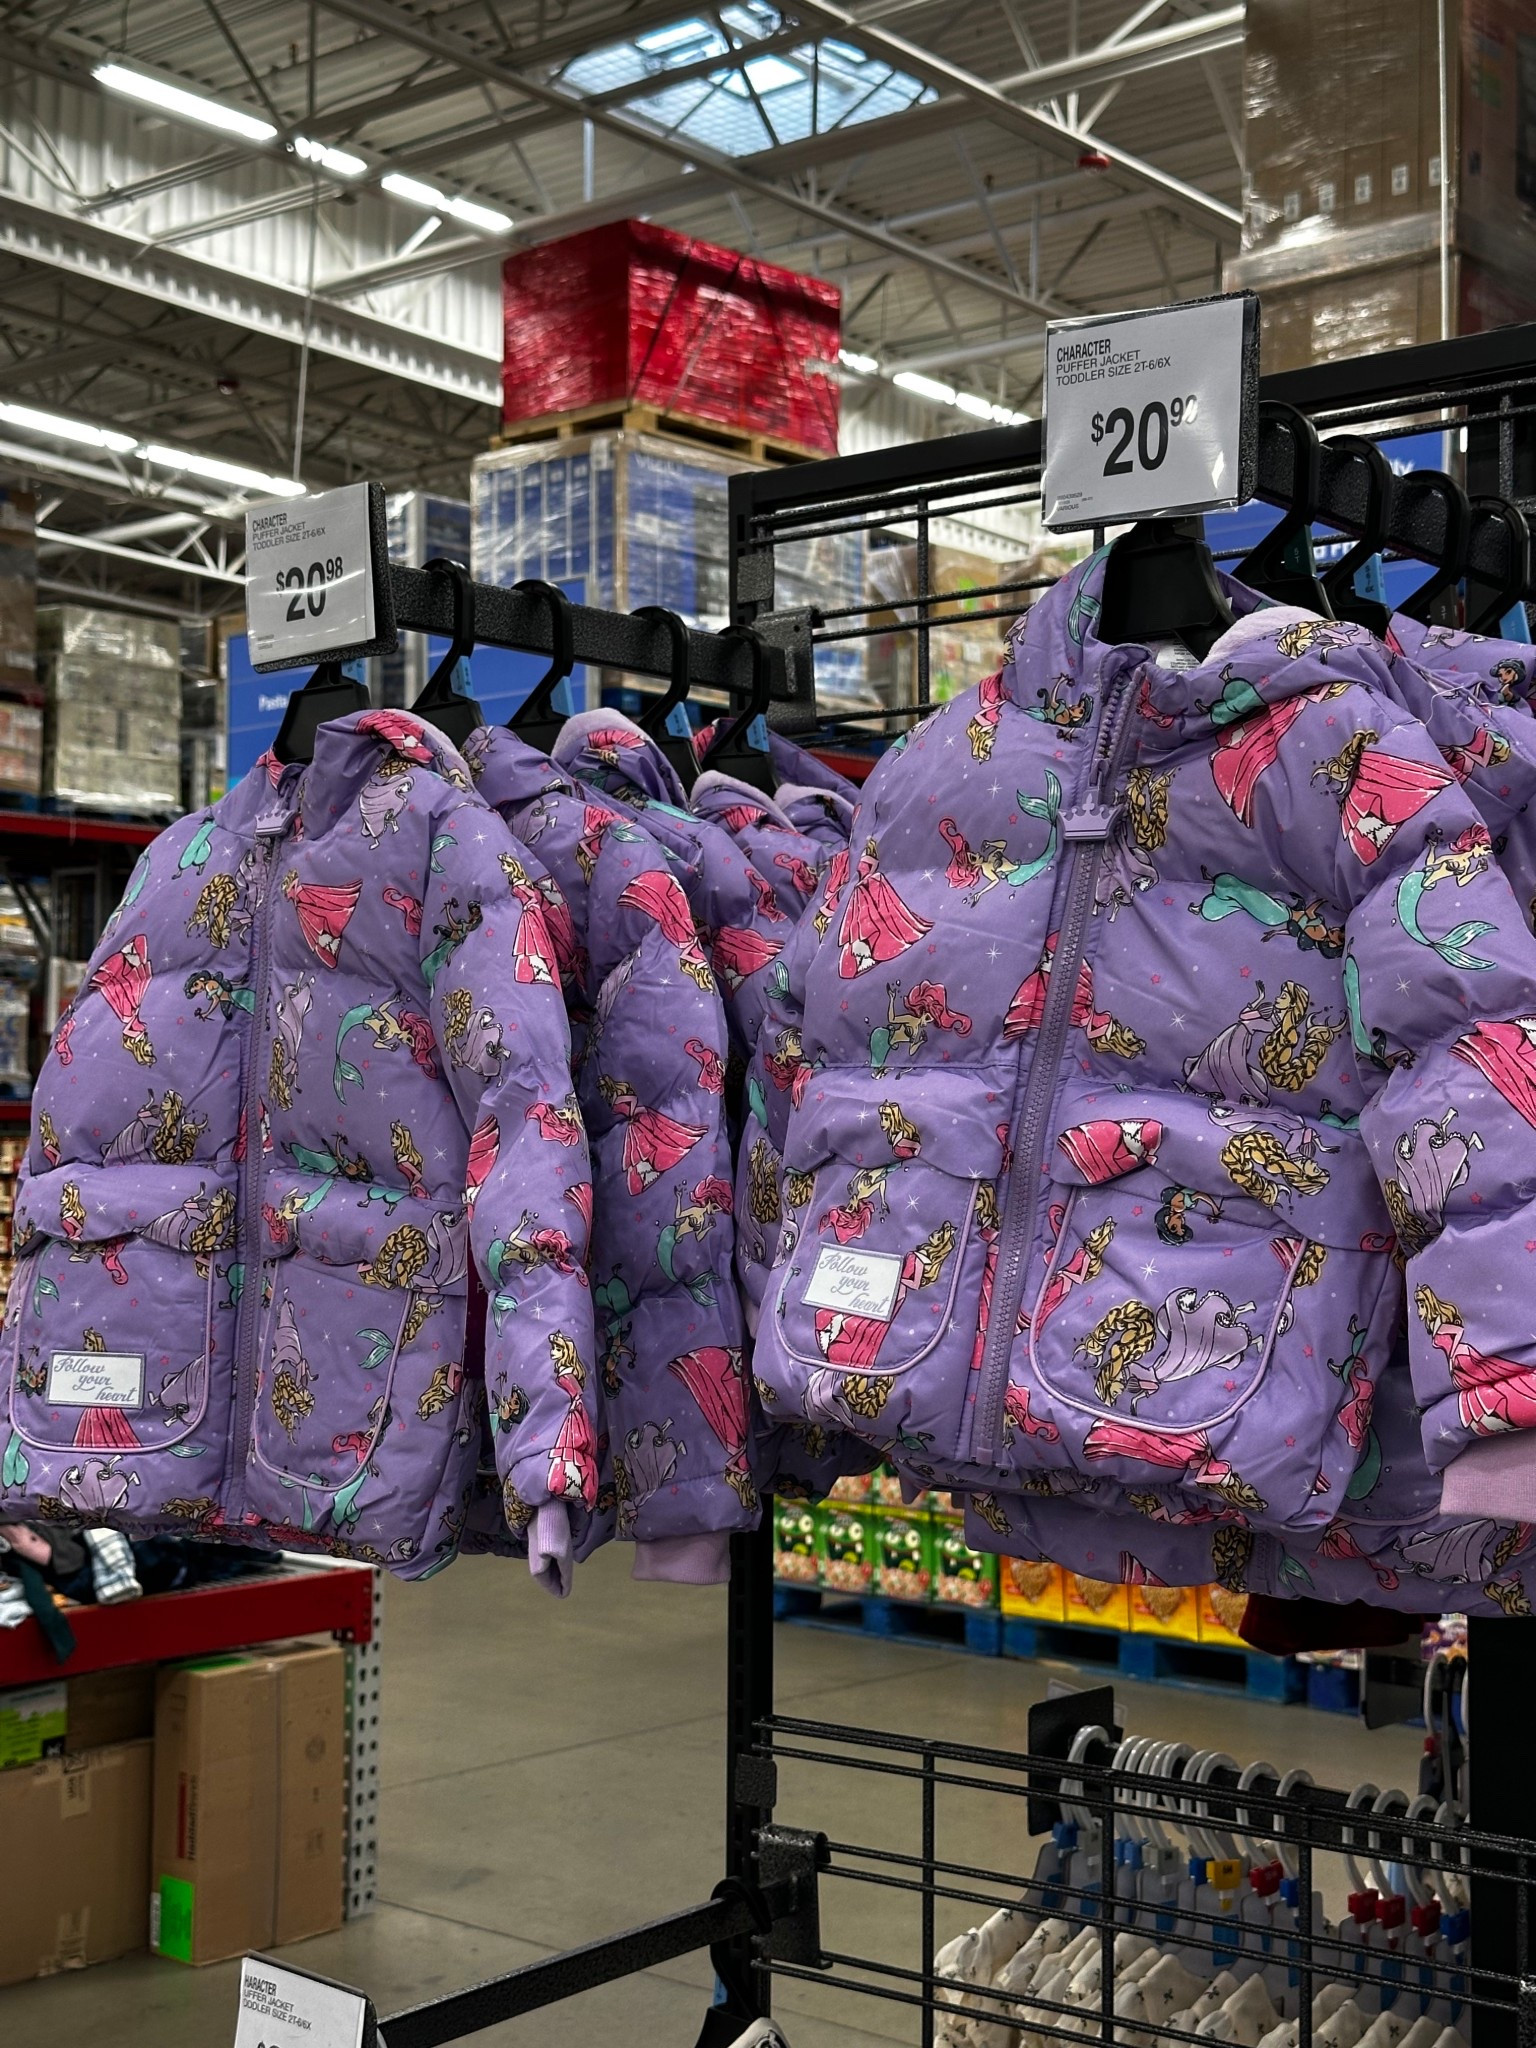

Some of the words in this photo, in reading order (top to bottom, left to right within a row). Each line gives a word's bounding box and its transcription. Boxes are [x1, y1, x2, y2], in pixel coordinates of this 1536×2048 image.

[1057, 339, 1111, 363] CHARACTER
[1056, 358, 1098, 375] PUFFER
[1100, 350, 1141, 367] JACKET
[1056, 369, 1105, 386] TODDLER
[1108, 364, 1131, 377] SIZE
[1133, 356, 1171, 373] 2T-6/6X
[253, 513, 288, 532] CHARACTER
[253, 528, 279, 541] PUFFER
[281, 521, 306, 535] JACKET
[253, 536, 284, 551] TODDLER
[285, 532, 301, 543] SIZE
[819, 1252, 868, 1276] Follow
[831, 1276, 870, 1295] your
[848, 1293, 890, 1313] heart
[54, 1356, 105, 1374] Follow
[72, 1375, 112, 1391] your
[95, 1386, 137, 1402] heart
[244, 1974, 277, 1997] HARACTER
[244, 1988, 267, 2003] UFFER
[268, 1996, 295, 2012] JACKET
[272, 2008, 287, 2022] SIZE
